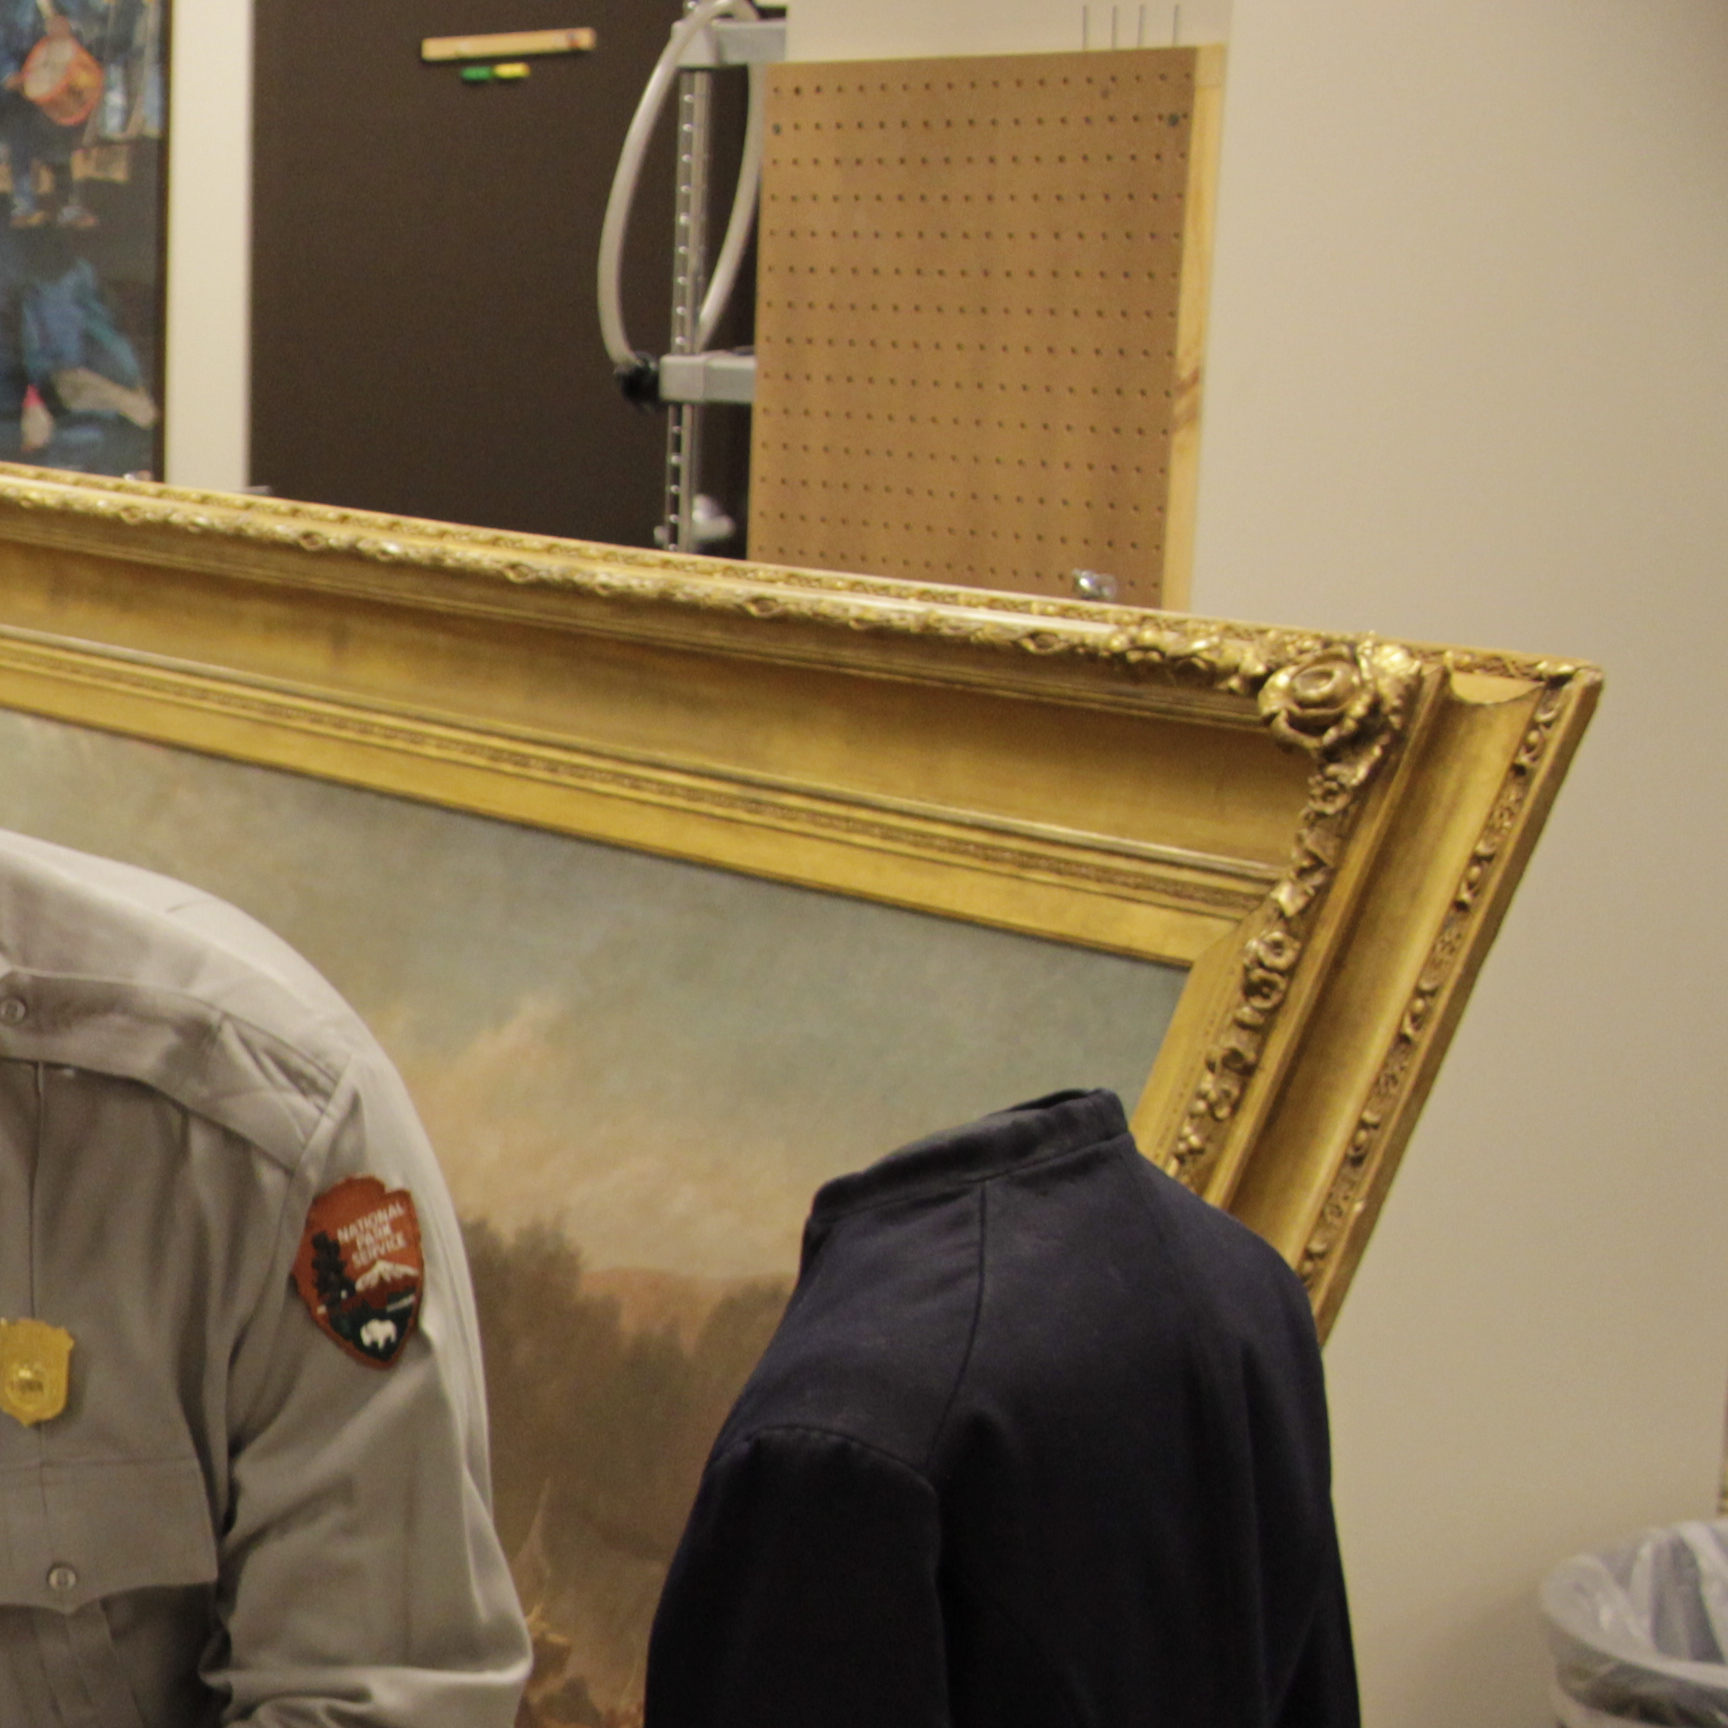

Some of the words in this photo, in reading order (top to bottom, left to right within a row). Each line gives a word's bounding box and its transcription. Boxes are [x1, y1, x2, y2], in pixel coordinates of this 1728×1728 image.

[337, 1200, 405, 1245] NATIONAL
[356, 1223, 392, 1251] PARK
[351, 1232, 407, 1269] SERVICE
